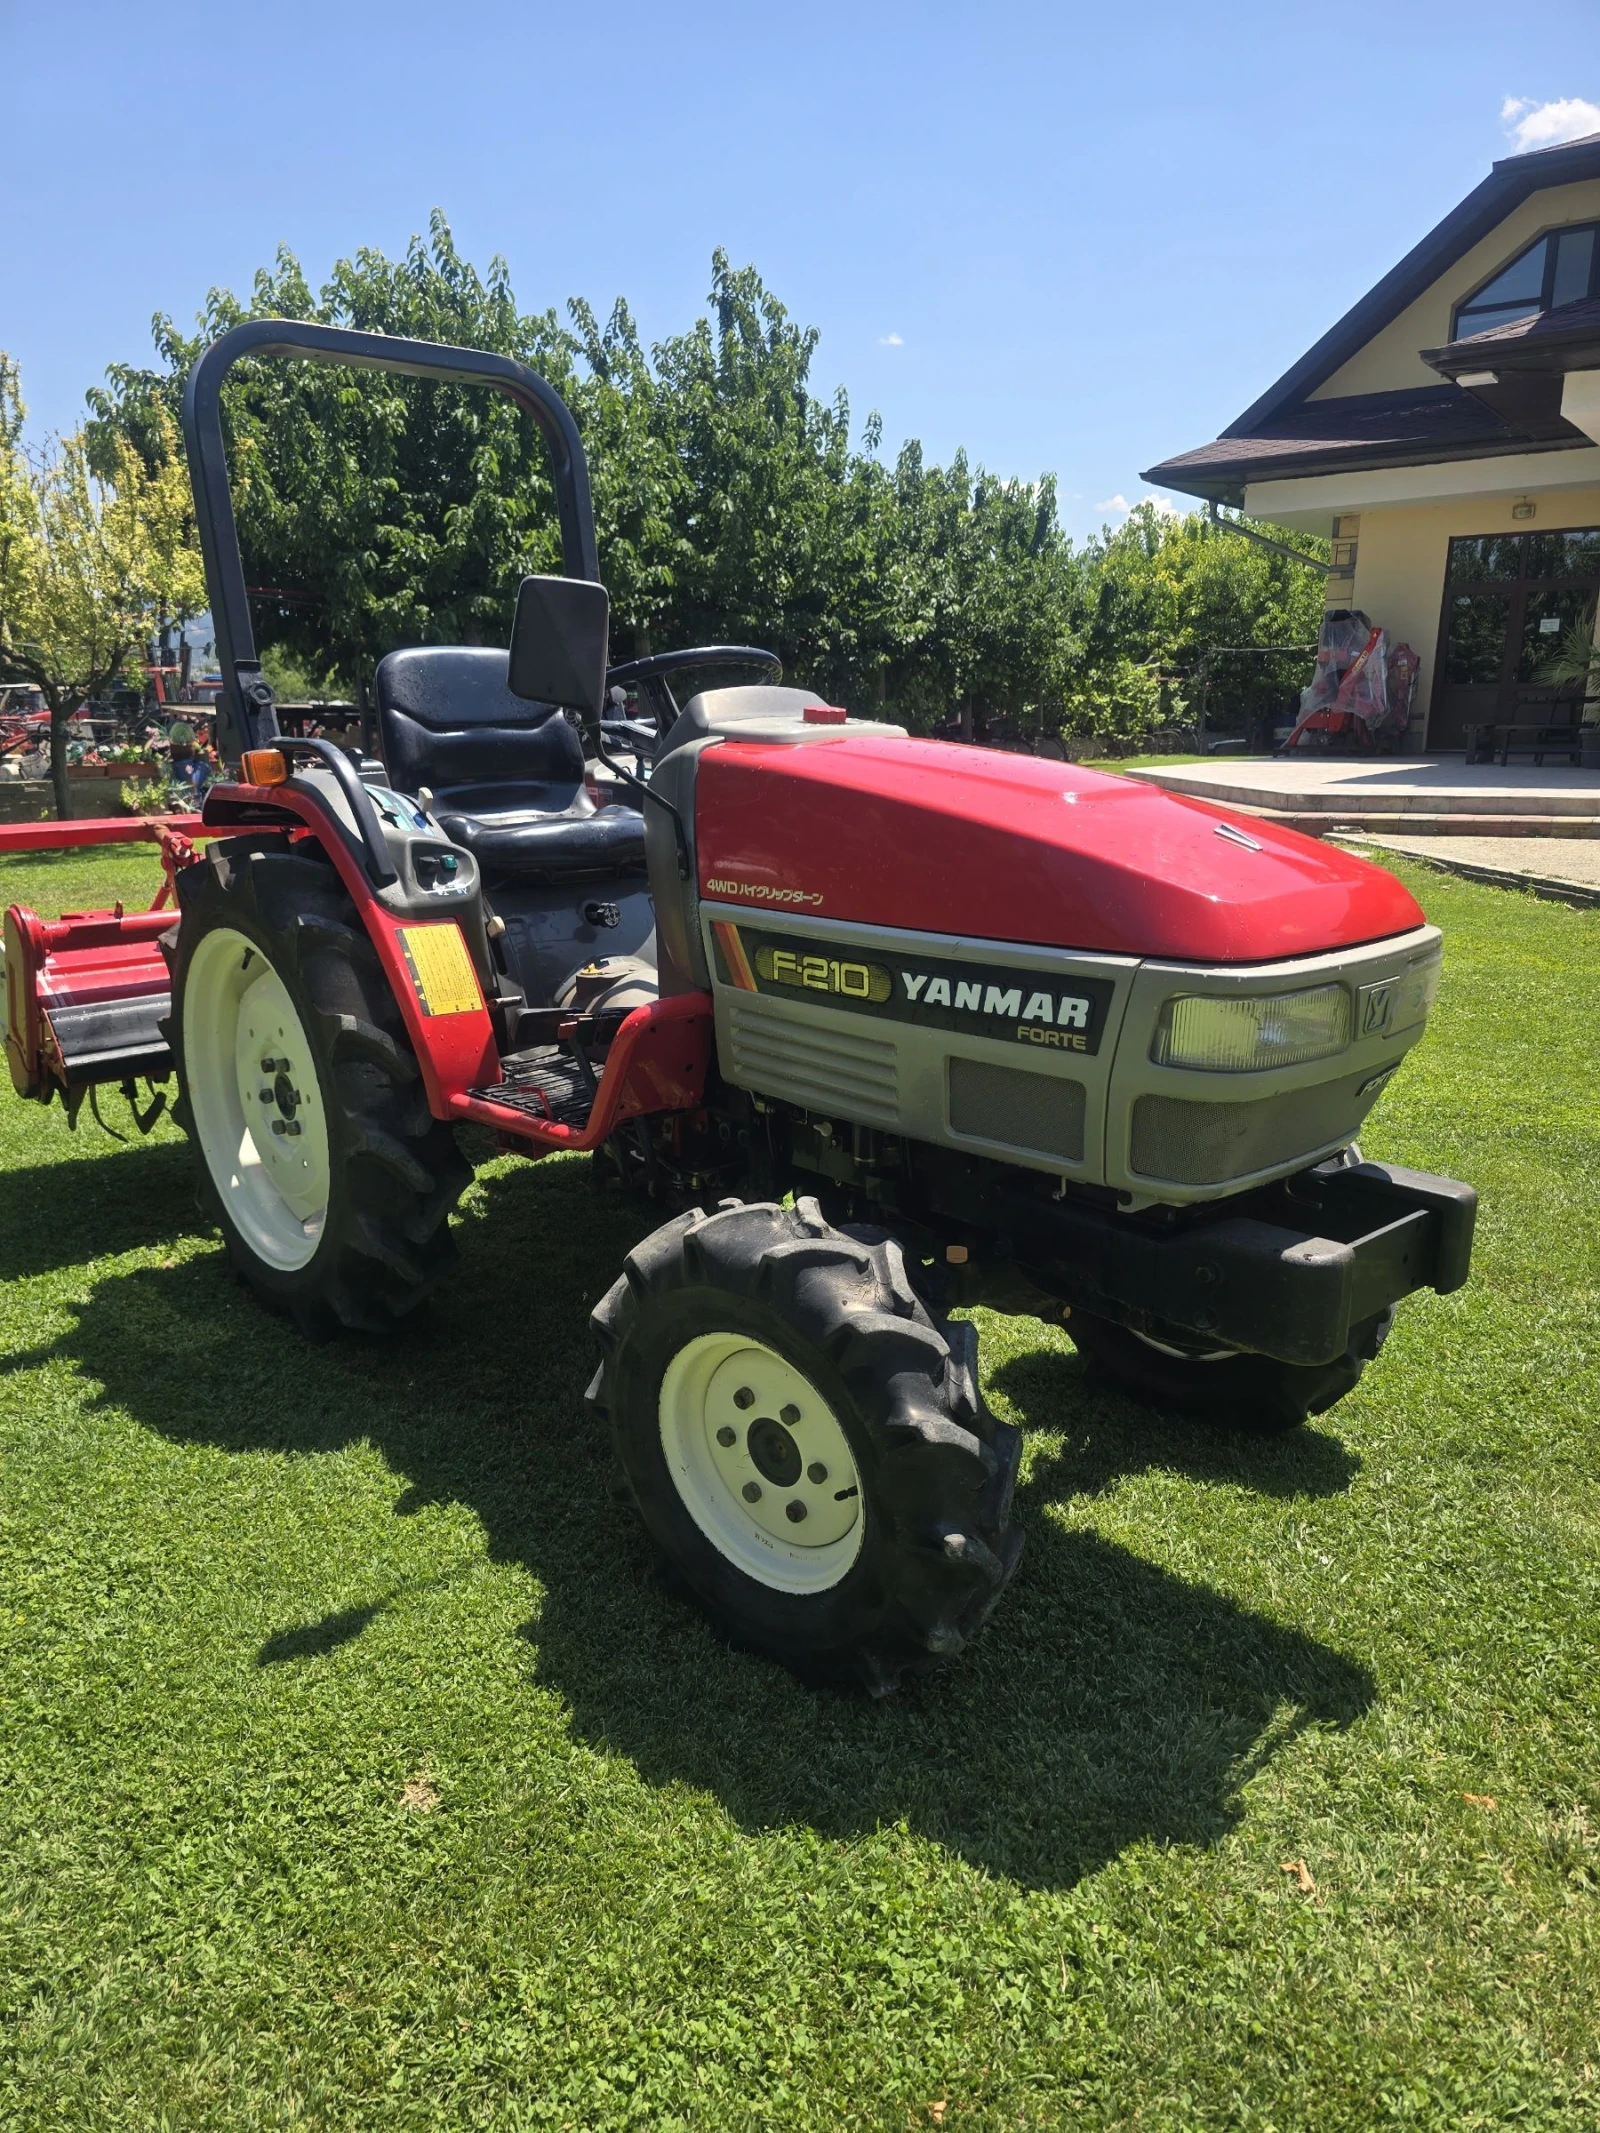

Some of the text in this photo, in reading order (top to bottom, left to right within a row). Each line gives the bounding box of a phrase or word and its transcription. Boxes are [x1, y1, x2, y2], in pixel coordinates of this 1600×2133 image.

[706, 878, 737, 894] 4WD
[772, 950, 870, 997] F-210
[901, 972, 1090, 1027] YANMAR
[1017, 1026, 1087, 1050] FORTE
